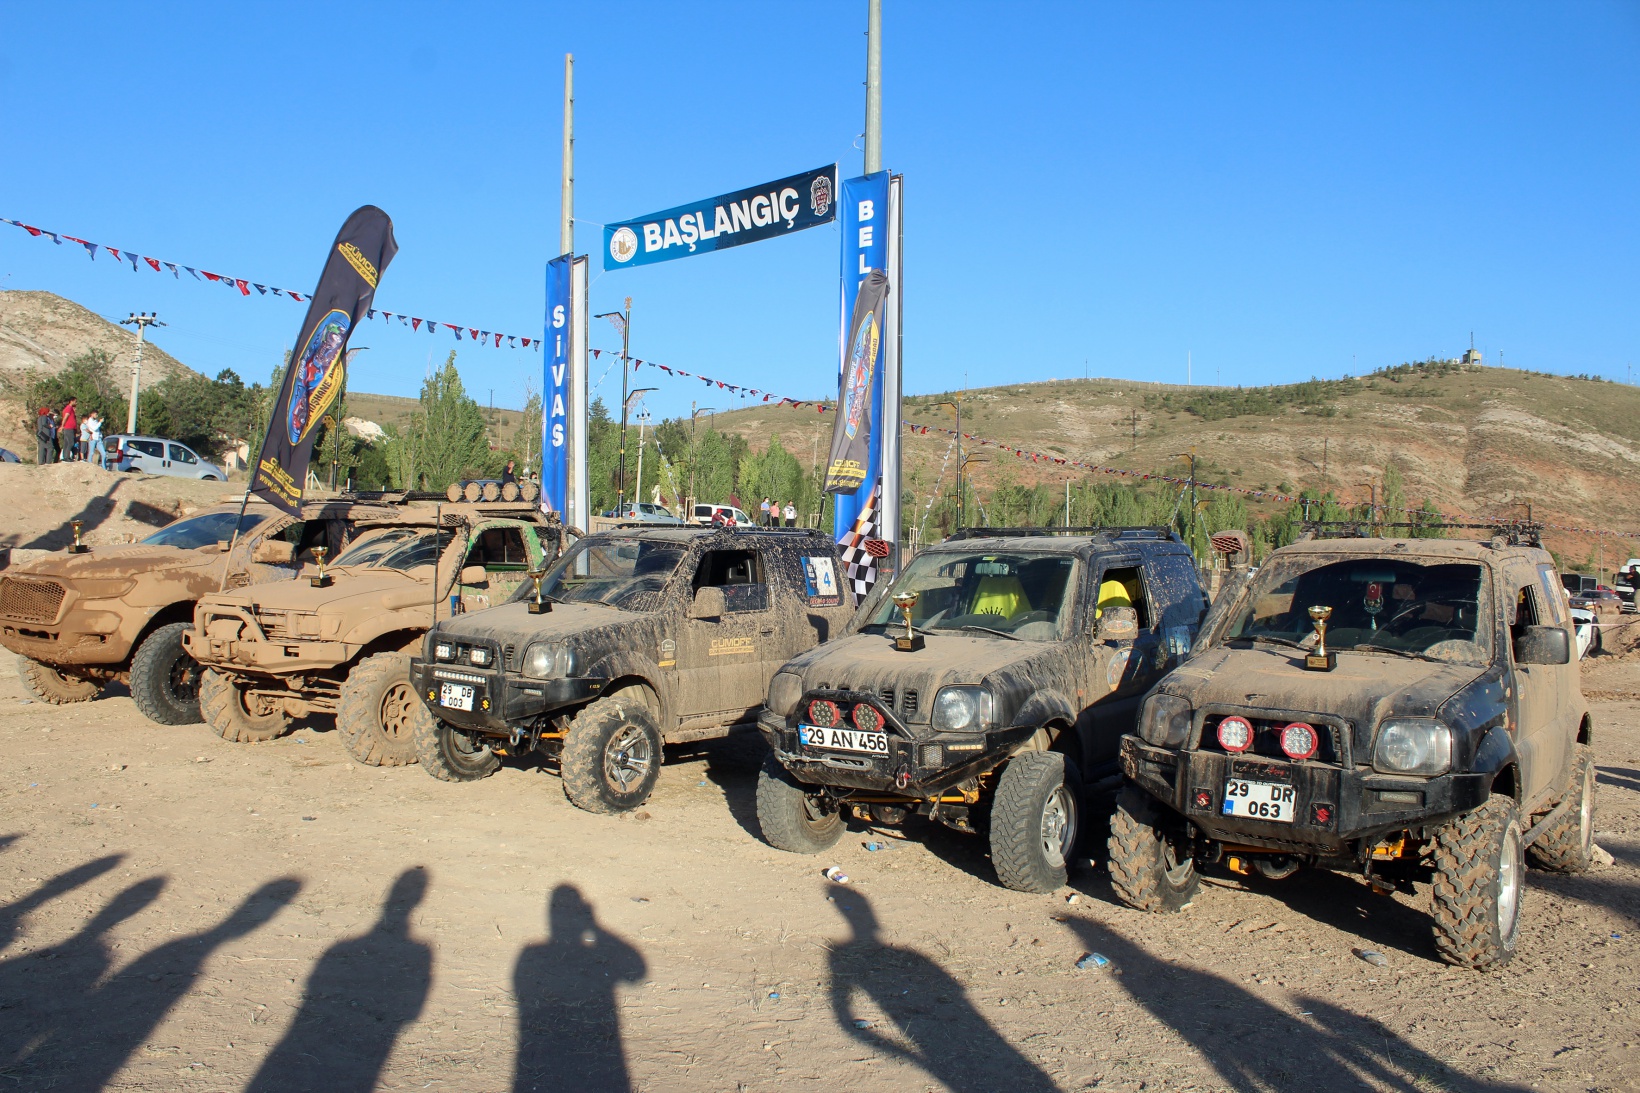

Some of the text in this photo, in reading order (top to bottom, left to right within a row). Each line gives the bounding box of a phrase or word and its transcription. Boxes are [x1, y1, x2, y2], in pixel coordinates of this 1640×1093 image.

[643, 187, 800, 253] BAŞLANGIÇ
[858, 200, 875, 291] BEL
[823, 571, 831, 587] 4
[442, 684, 453, 695] 29
[448, 696, 463, 708] 003
[807, 727, 887, 751] 29 AN 456
[1228, 782, 1293, 803] 29 DR
[1247, 801, 1281, 819] 063
